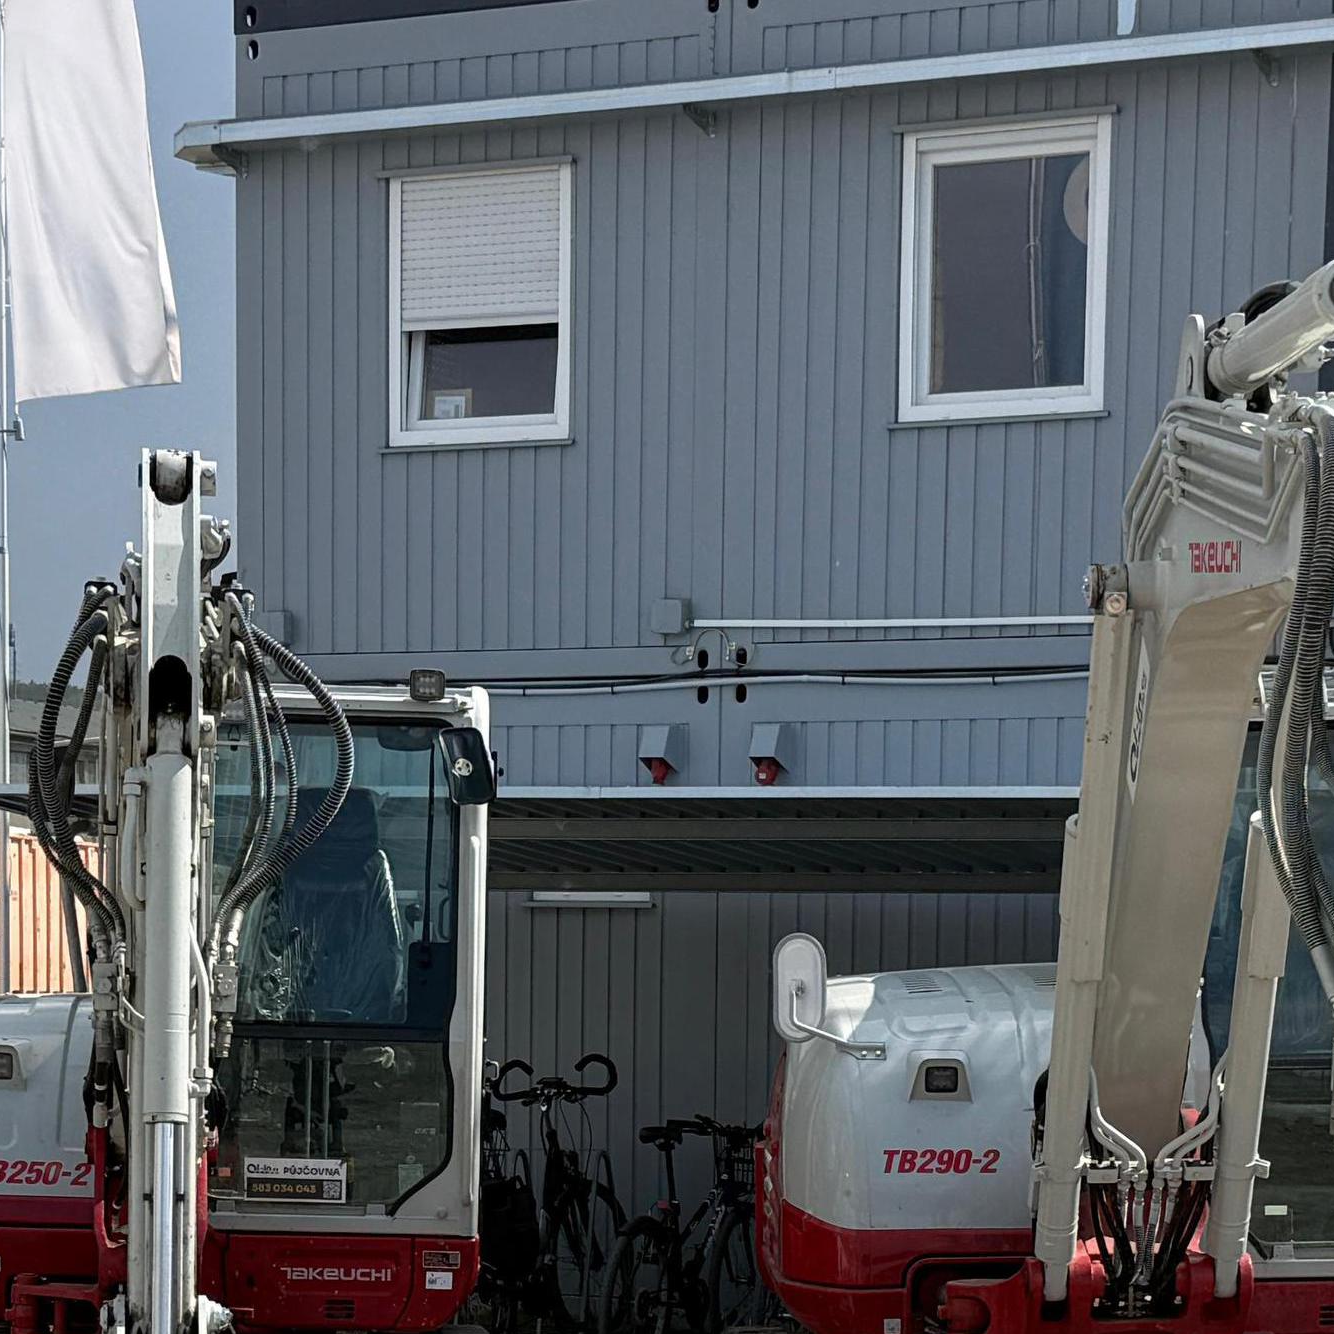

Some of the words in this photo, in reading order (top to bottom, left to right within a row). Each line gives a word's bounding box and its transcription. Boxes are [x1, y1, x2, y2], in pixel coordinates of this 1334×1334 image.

[1188, 540, 1242, 574] TAKEUCHI
[283, 1165, 341, 1177] PŮJČOVNA
[883, 1149, 1001, 1174] TB290-2
[280, 1267, 392, 1282] TAKEUCHI
